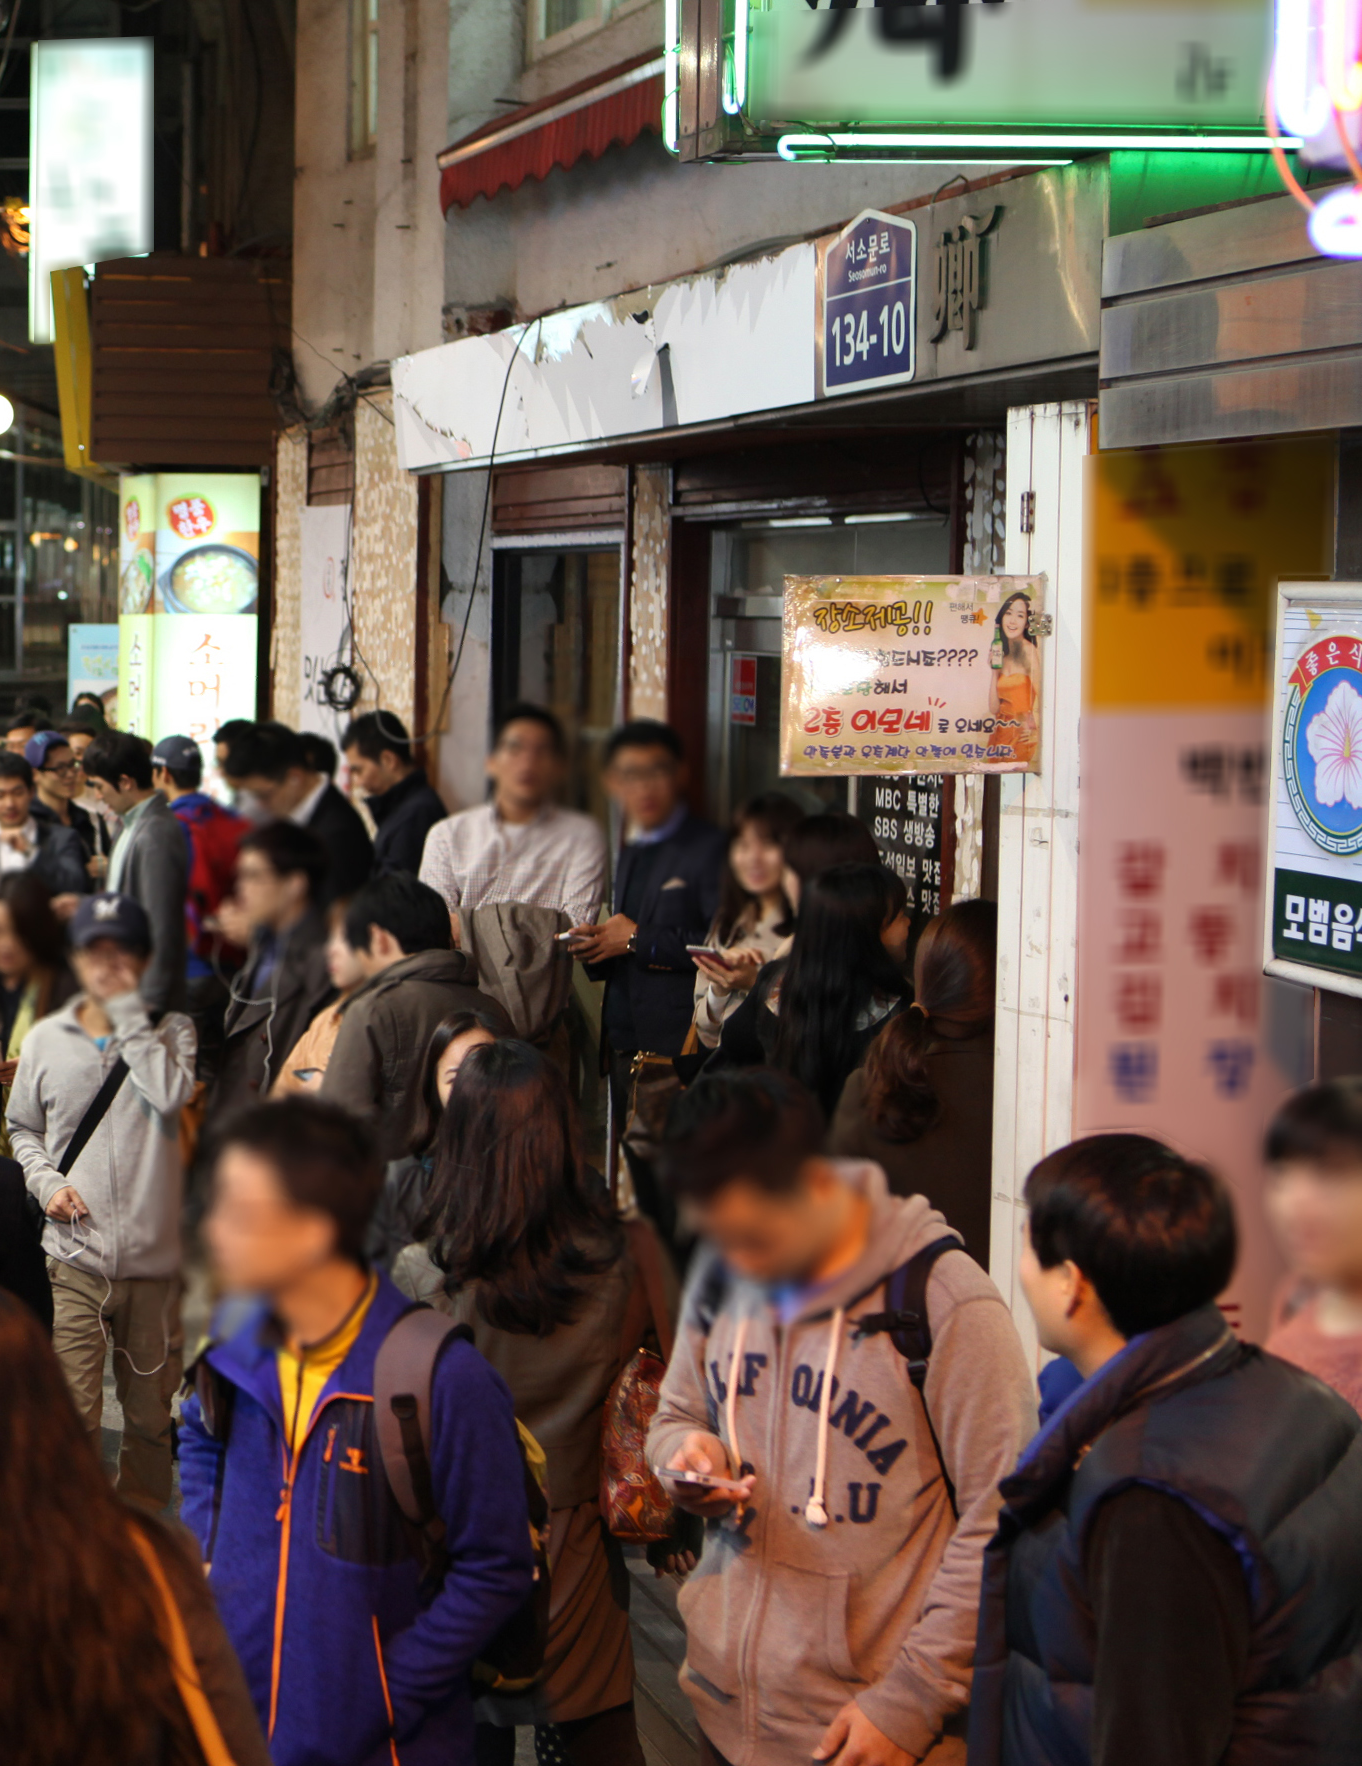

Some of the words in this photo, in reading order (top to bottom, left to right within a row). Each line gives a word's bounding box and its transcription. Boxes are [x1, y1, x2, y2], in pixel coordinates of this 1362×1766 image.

[845, 231, 891, 264] 서소문로
[847, 262, 887, 283] Seosomun-ro
[831, 300, 906, 368] 134-10
[813, 600, 933, 637] 장소제공!!
[1305, 641, 1341, 676] 좋은
[803, 706, 842, 738] 2층
[850, 708, 932, 734] 어모네
[960, 743, 1016, 760] 있습니다.
[875, 787, 901, 811] MBC
[906, 790, 940, 819] 특별한
[874, 815, 898, 840] SBS
[903, 819, 936, 849] 생방송
[922, 859, 941, 886] 맛집
[921, 889, 940, 916] 맛집
